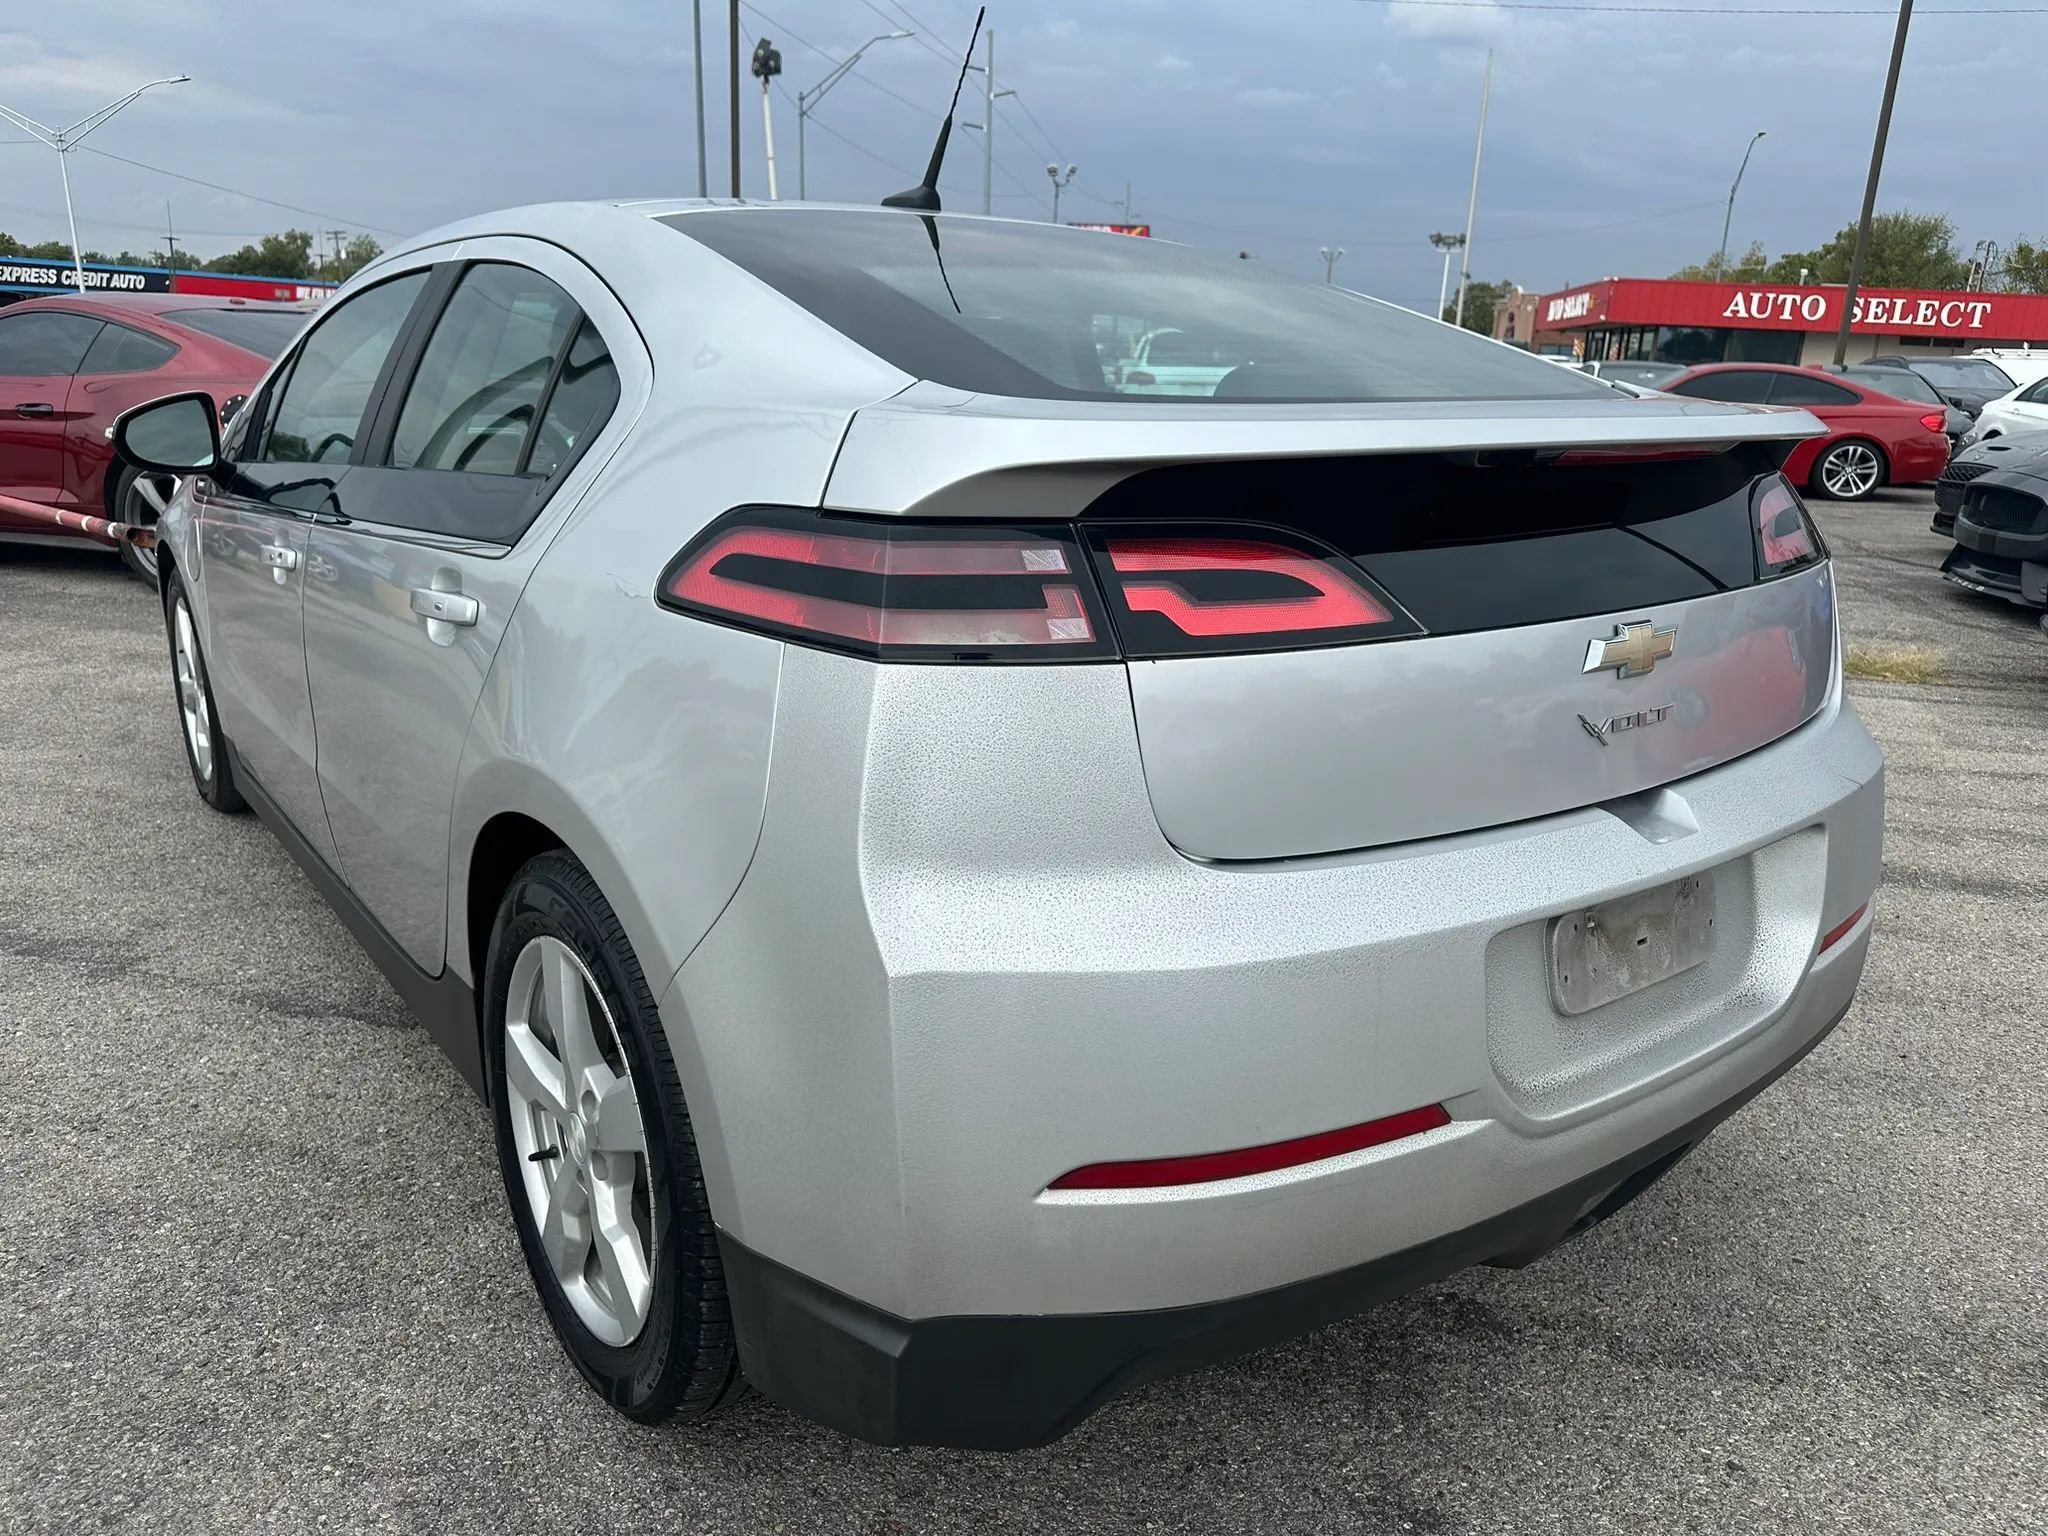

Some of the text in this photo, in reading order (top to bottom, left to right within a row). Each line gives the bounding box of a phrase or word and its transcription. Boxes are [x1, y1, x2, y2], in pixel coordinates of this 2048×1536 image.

[110, 274, 146, 289] AUTO
[1722, 291, 1991, 328] AUTO SELECT
[1577, 703, 1674, 746] VOLT
